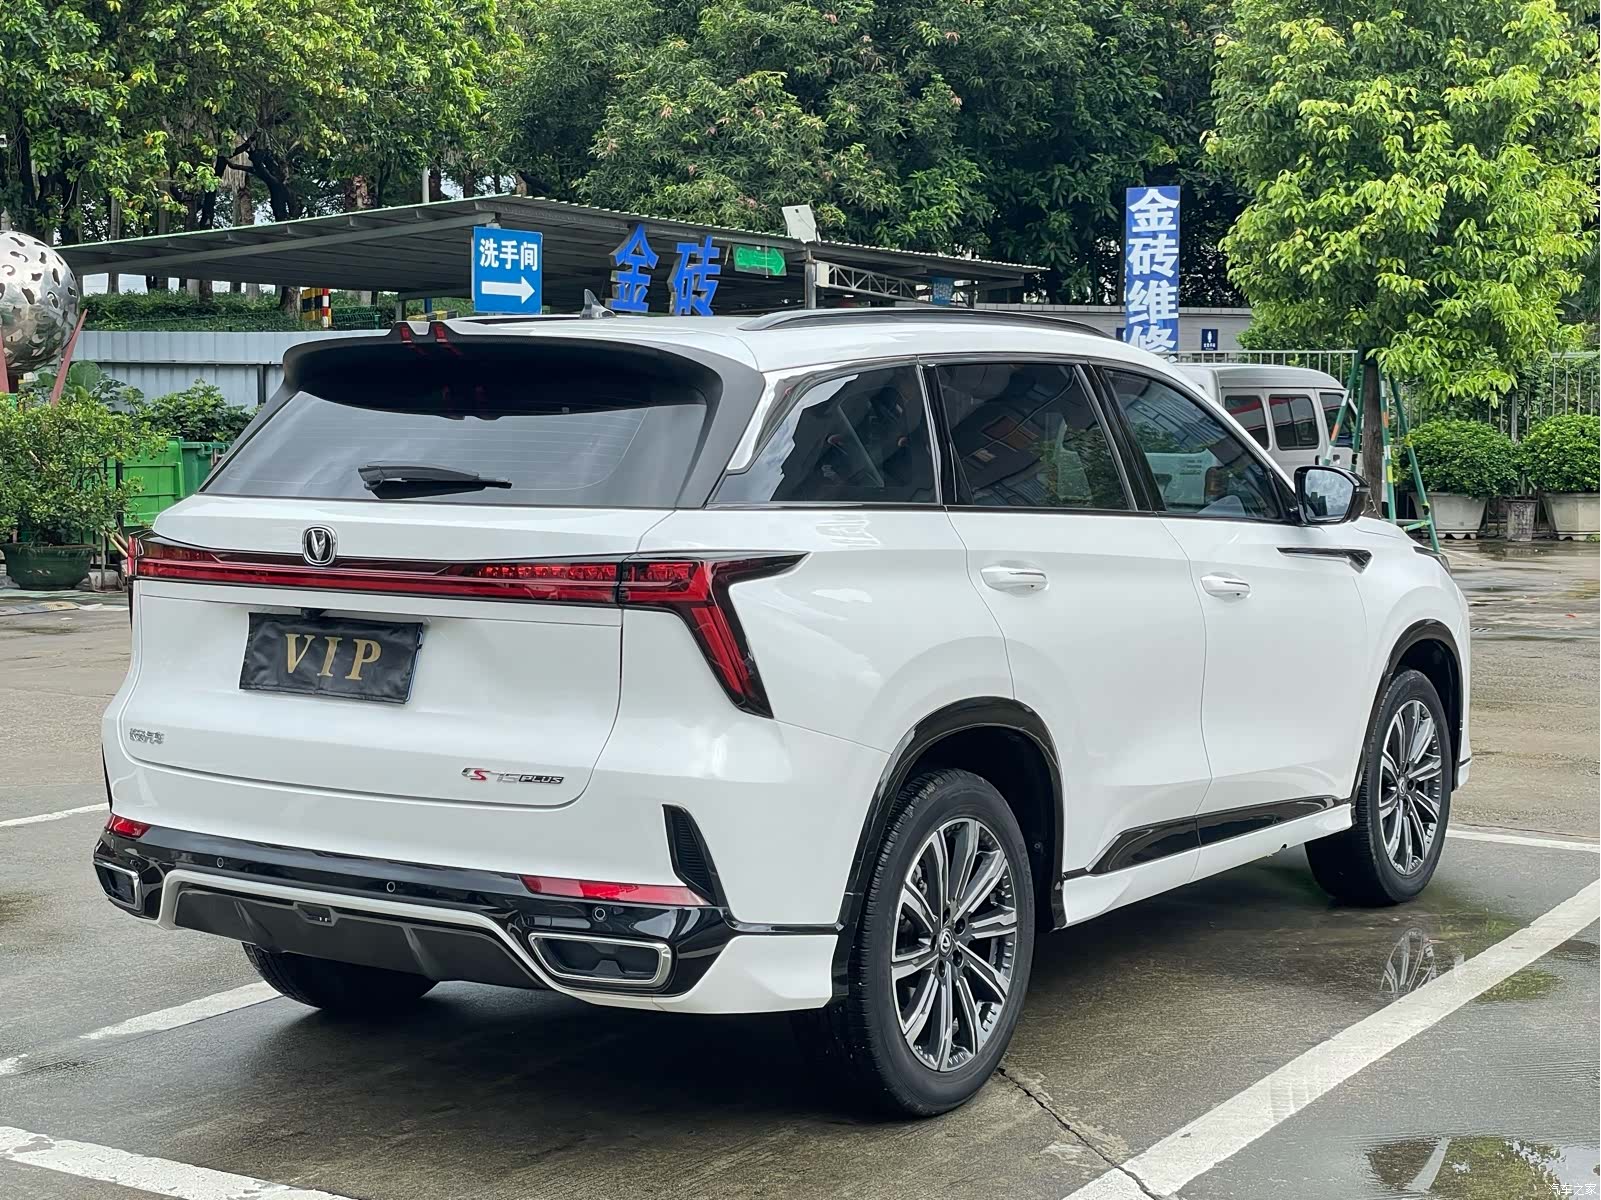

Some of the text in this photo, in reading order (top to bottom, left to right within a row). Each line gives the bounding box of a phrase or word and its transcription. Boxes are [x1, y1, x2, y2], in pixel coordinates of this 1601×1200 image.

[479, 238, 538, 271] 洗手间
[609, 224, 721, 316] 金砖
[285, 633, 382, 680] VIP
